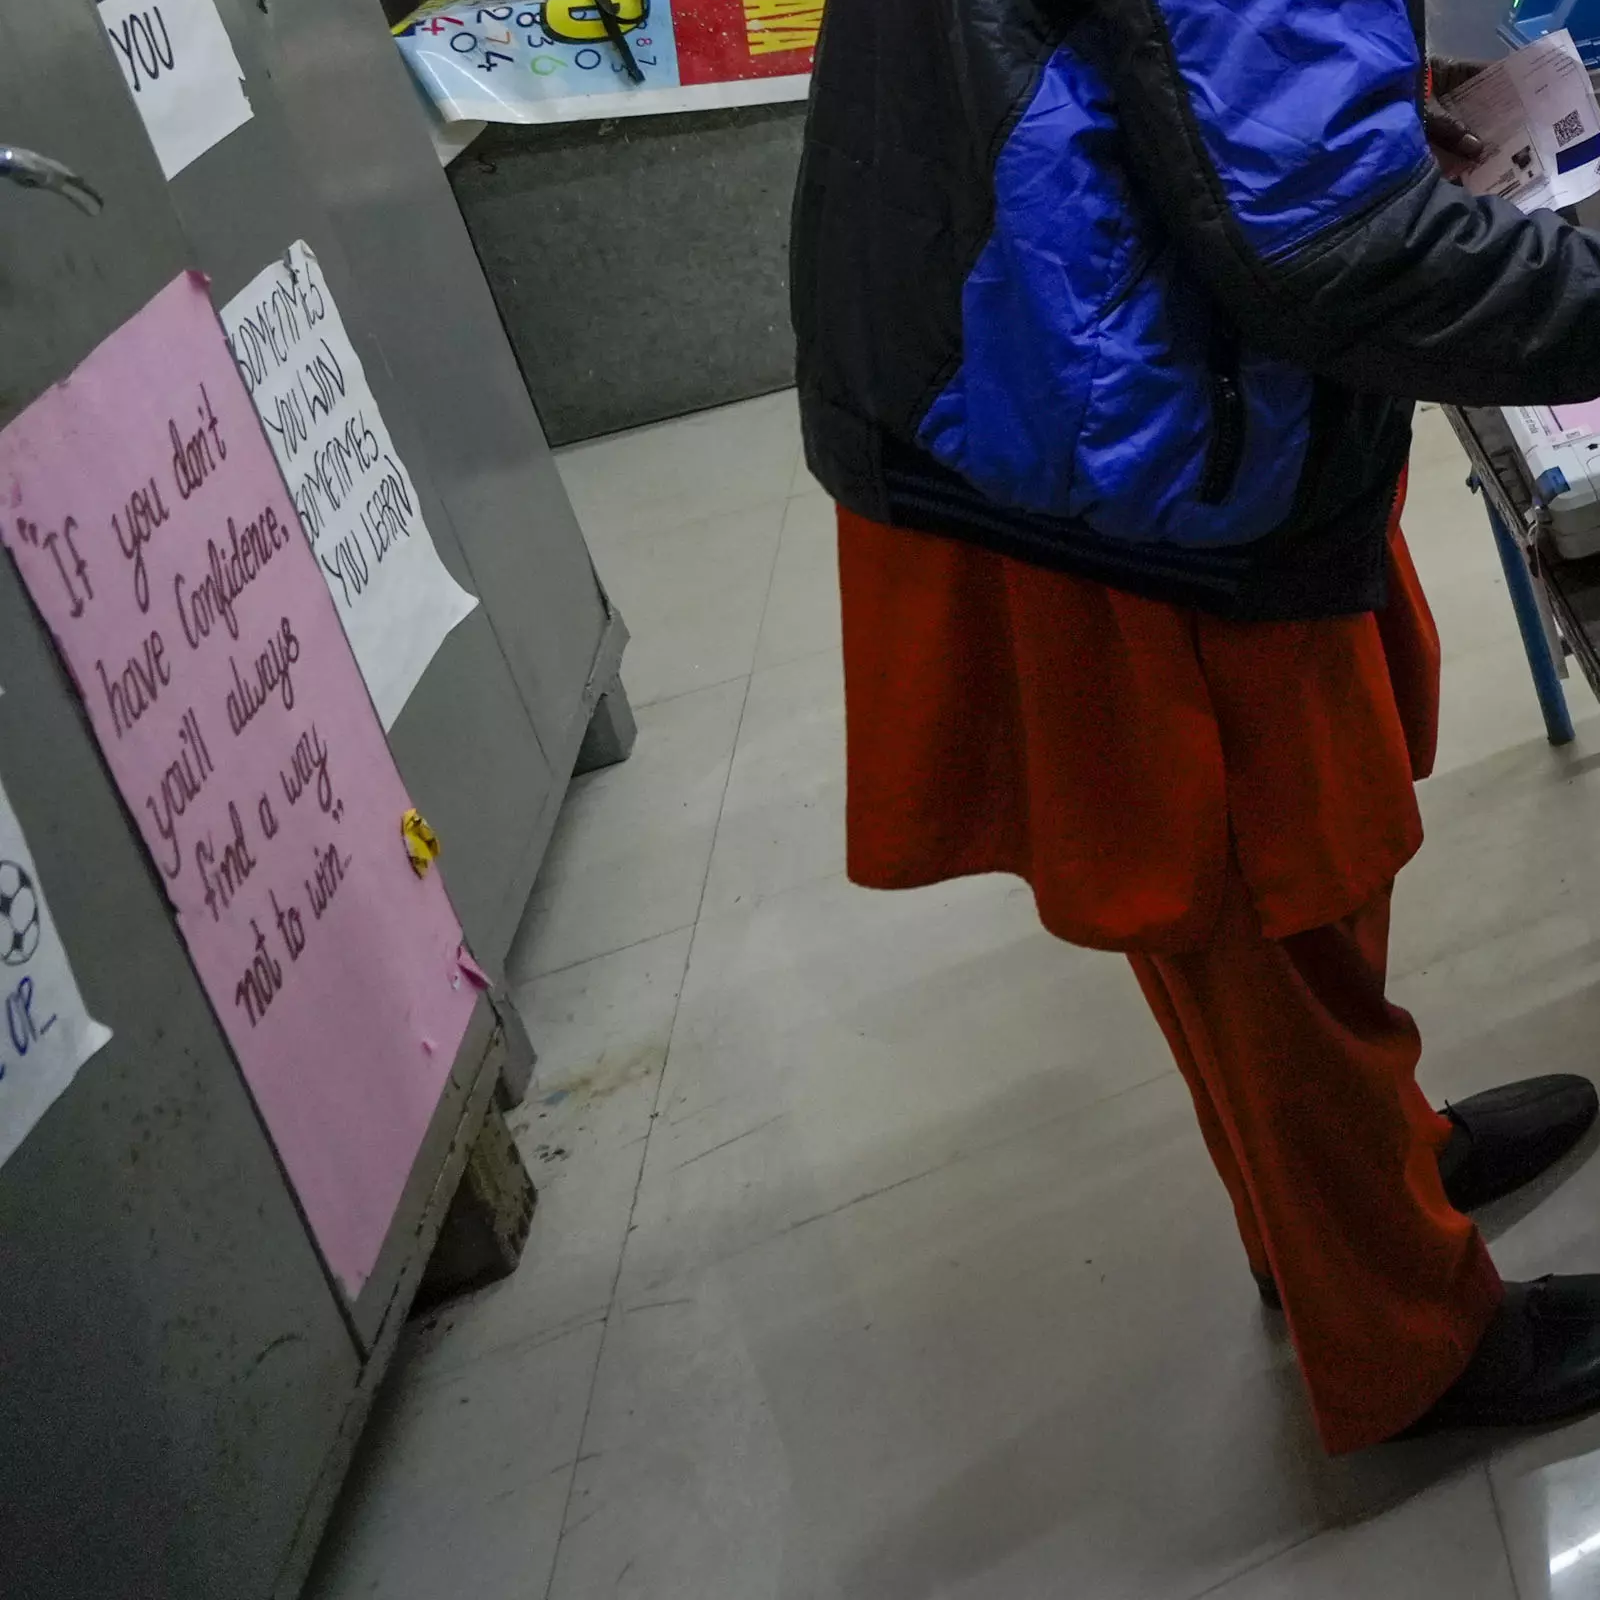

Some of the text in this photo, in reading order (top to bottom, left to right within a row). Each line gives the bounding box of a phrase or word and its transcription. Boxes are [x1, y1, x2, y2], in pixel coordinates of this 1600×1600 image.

[108, 5, 175, 92] YOU
[227, 262, 326, 394] SOMETIMES
[263, 337, 346, 462] YOU WIN
[111, 477, 170, 614] you
[168, 381, 227, 501] don't
[295, 409, 379, 546] SOMETIMES
[320, 453, 414, 608] YOU LEARN
[96, 630, 171, 740] have
[146, 616, 300, 881] you'll always
[195, 720, 333, 922] find a way
[235, 918, 283, 1029] not
[268, 888, 306, 962] to
